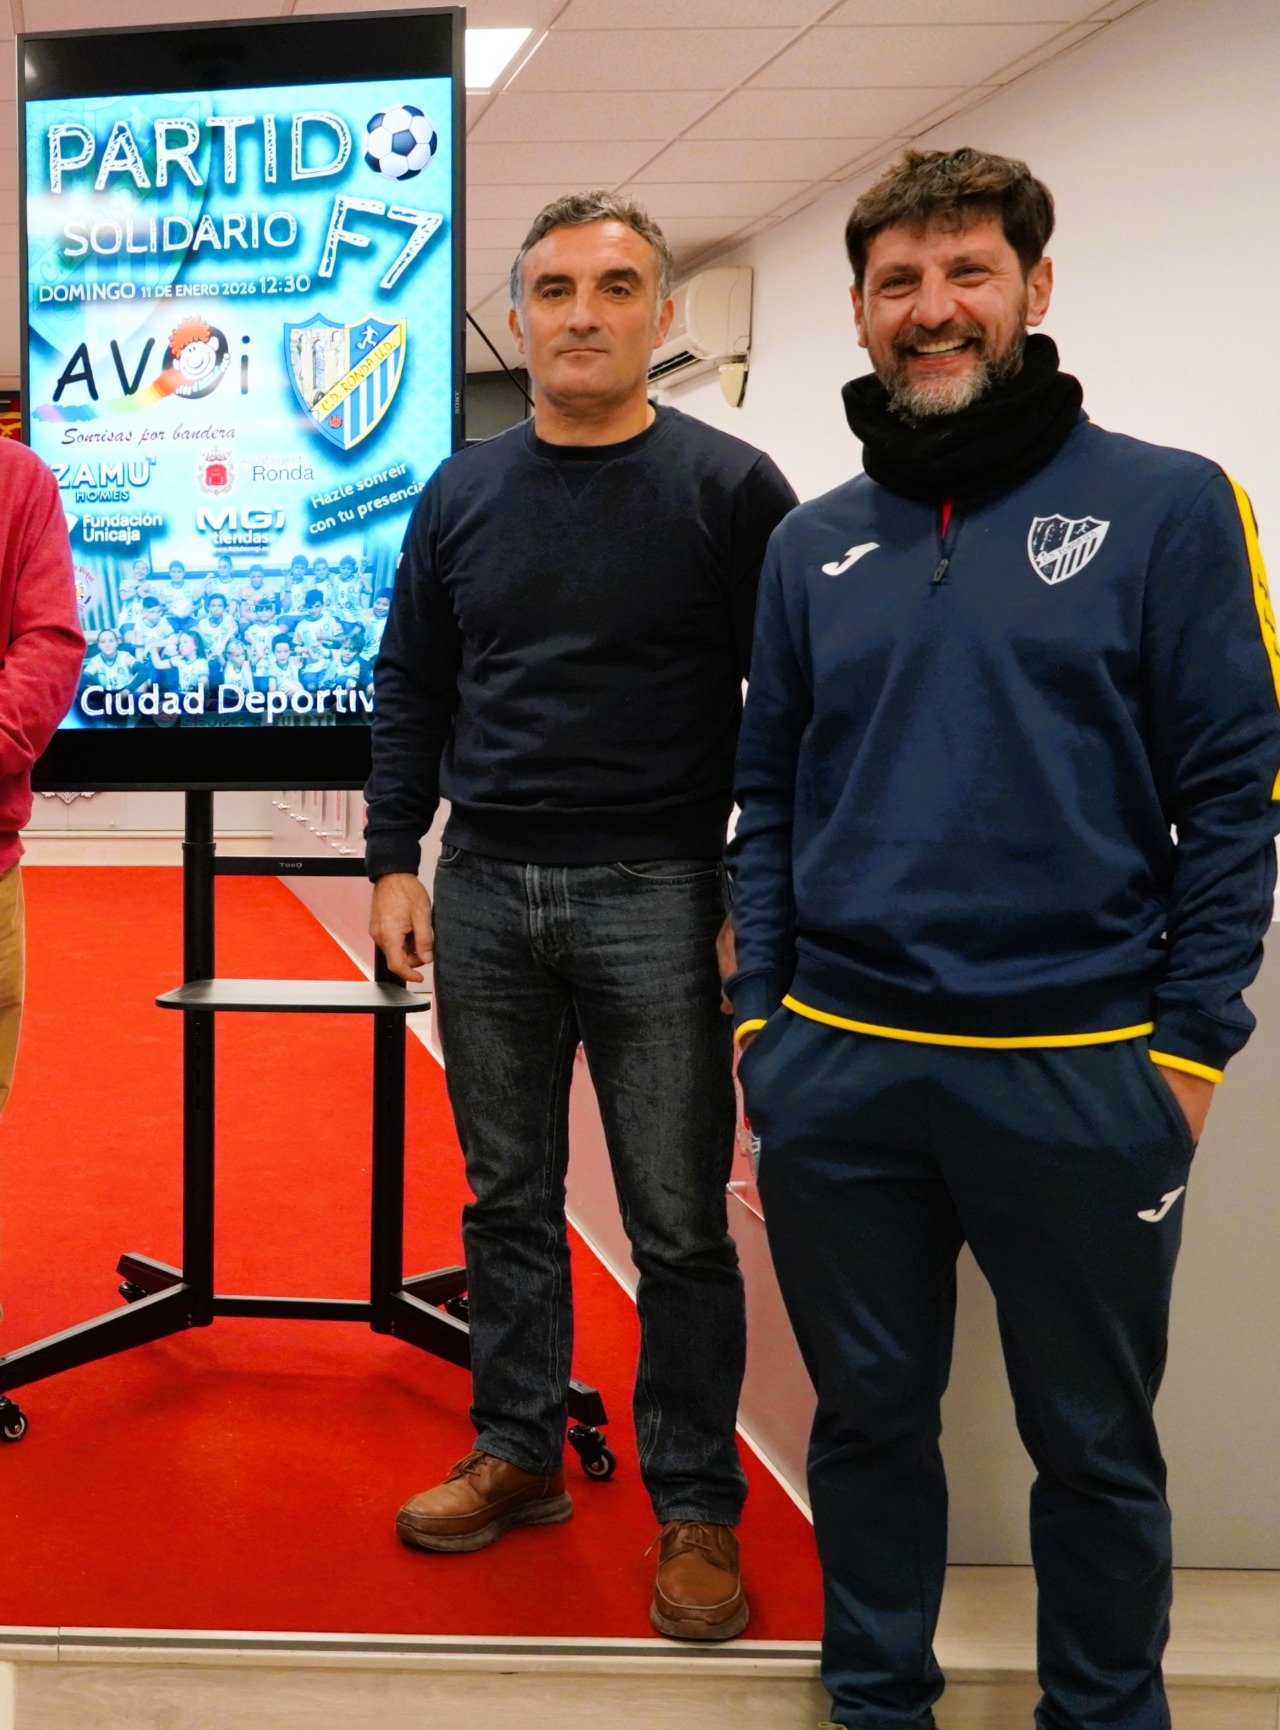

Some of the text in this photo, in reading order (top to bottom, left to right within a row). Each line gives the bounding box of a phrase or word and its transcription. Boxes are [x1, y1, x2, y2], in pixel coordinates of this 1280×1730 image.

[63, 212, 297, 257] SOLIDARIO
[318, 194, 443, 289] F7
[39, 274, 311, 302] DOMINGO 11 DE ENERO 2026 12:30
[321, 341, 397, 411] C.D. RONDA U.D.
[61, 423, 237, 446] Sonrisas por bandera
[252, 465, 314, 481] Ronda
[75, 490, 130, 503] HOMES
[309, 480, 426, 534] con tu presencia
[311, 484, 355, 509] Hazle
[82, 512, 163, 528] Fundación
[82, 528, 141, 545] Unicaja
[212, 529, 270, 545] tiendas
[1058, 539, 1083, 555] RONDA
[80, 683, 205, 716] Ciudad
